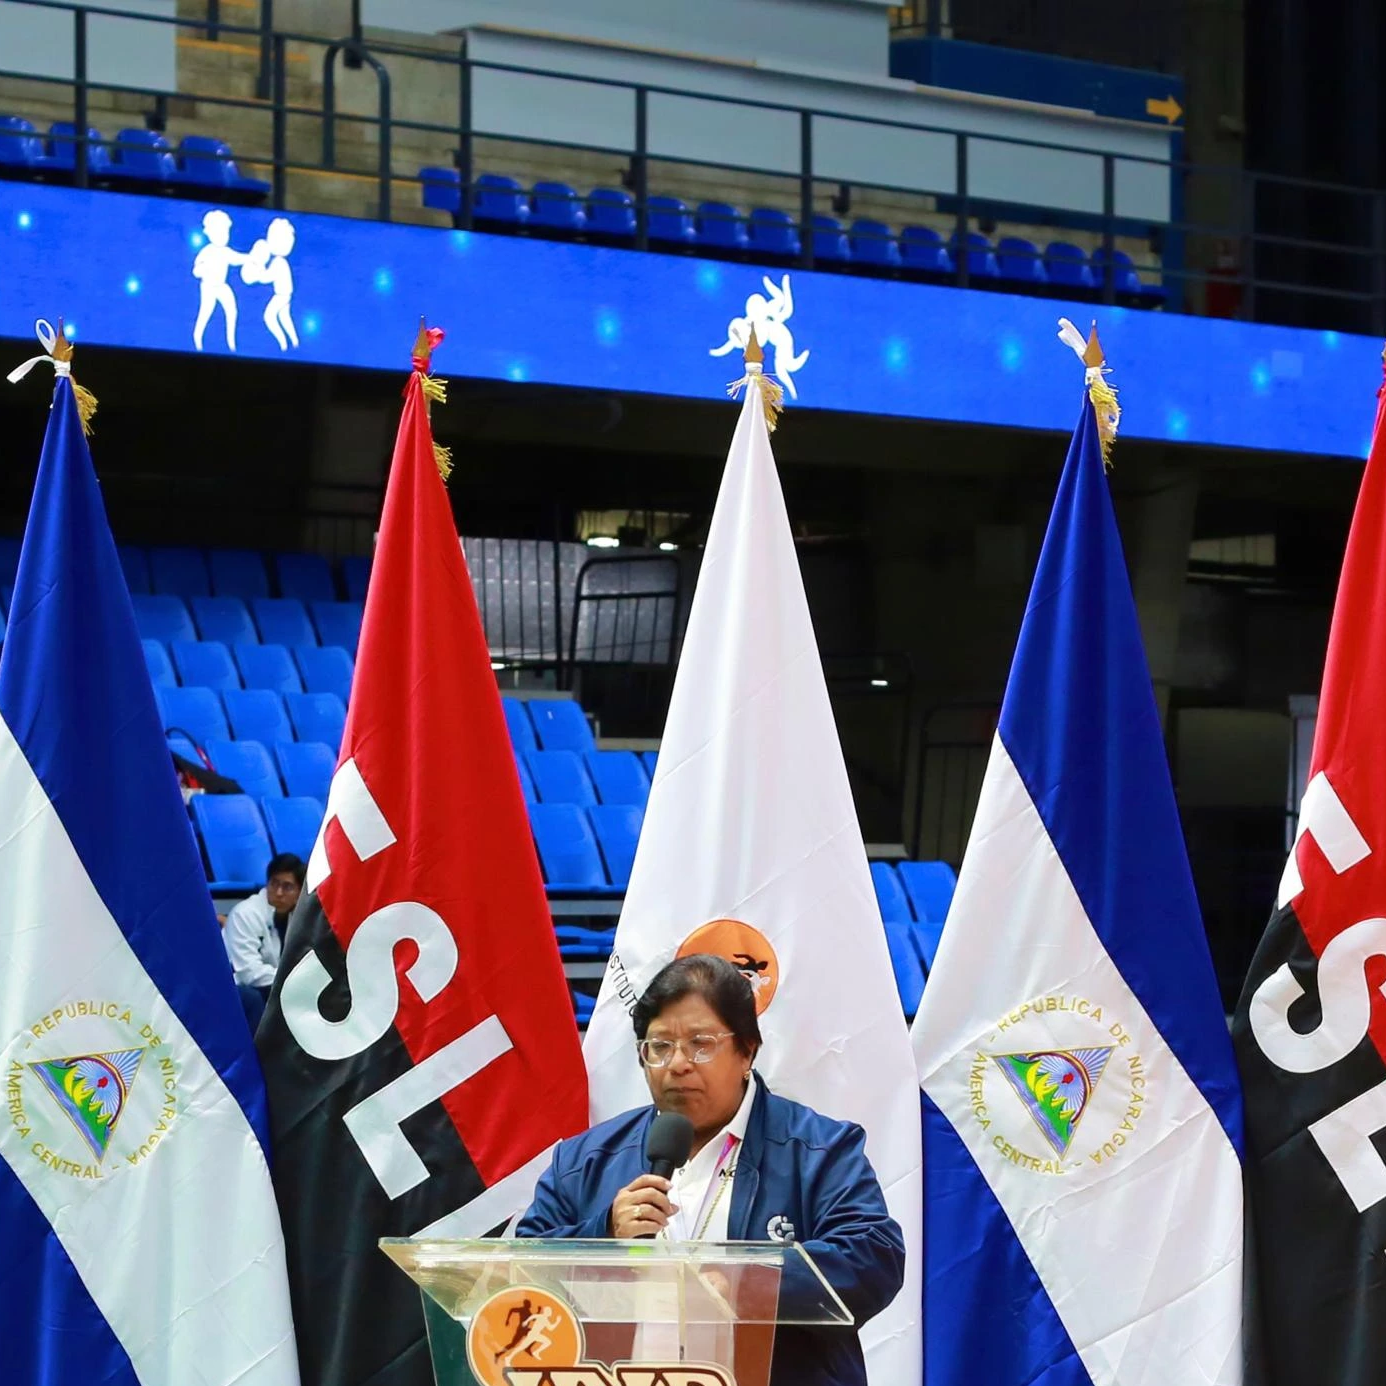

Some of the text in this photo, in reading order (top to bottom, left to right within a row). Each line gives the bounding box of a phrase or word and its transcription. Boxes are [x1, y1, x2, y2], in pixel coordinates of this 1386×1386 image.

[5, 1060, 104, 1179] AMERICA CENTRAL
[31, 1000, 178, 1166] REPUBLICA DE NICARAGUA
[969, 1051, 1066, 1174] AMERICA CENTRAL
[997, 995, 1147, 1164] REPUBLICA DE NICARAGUA
